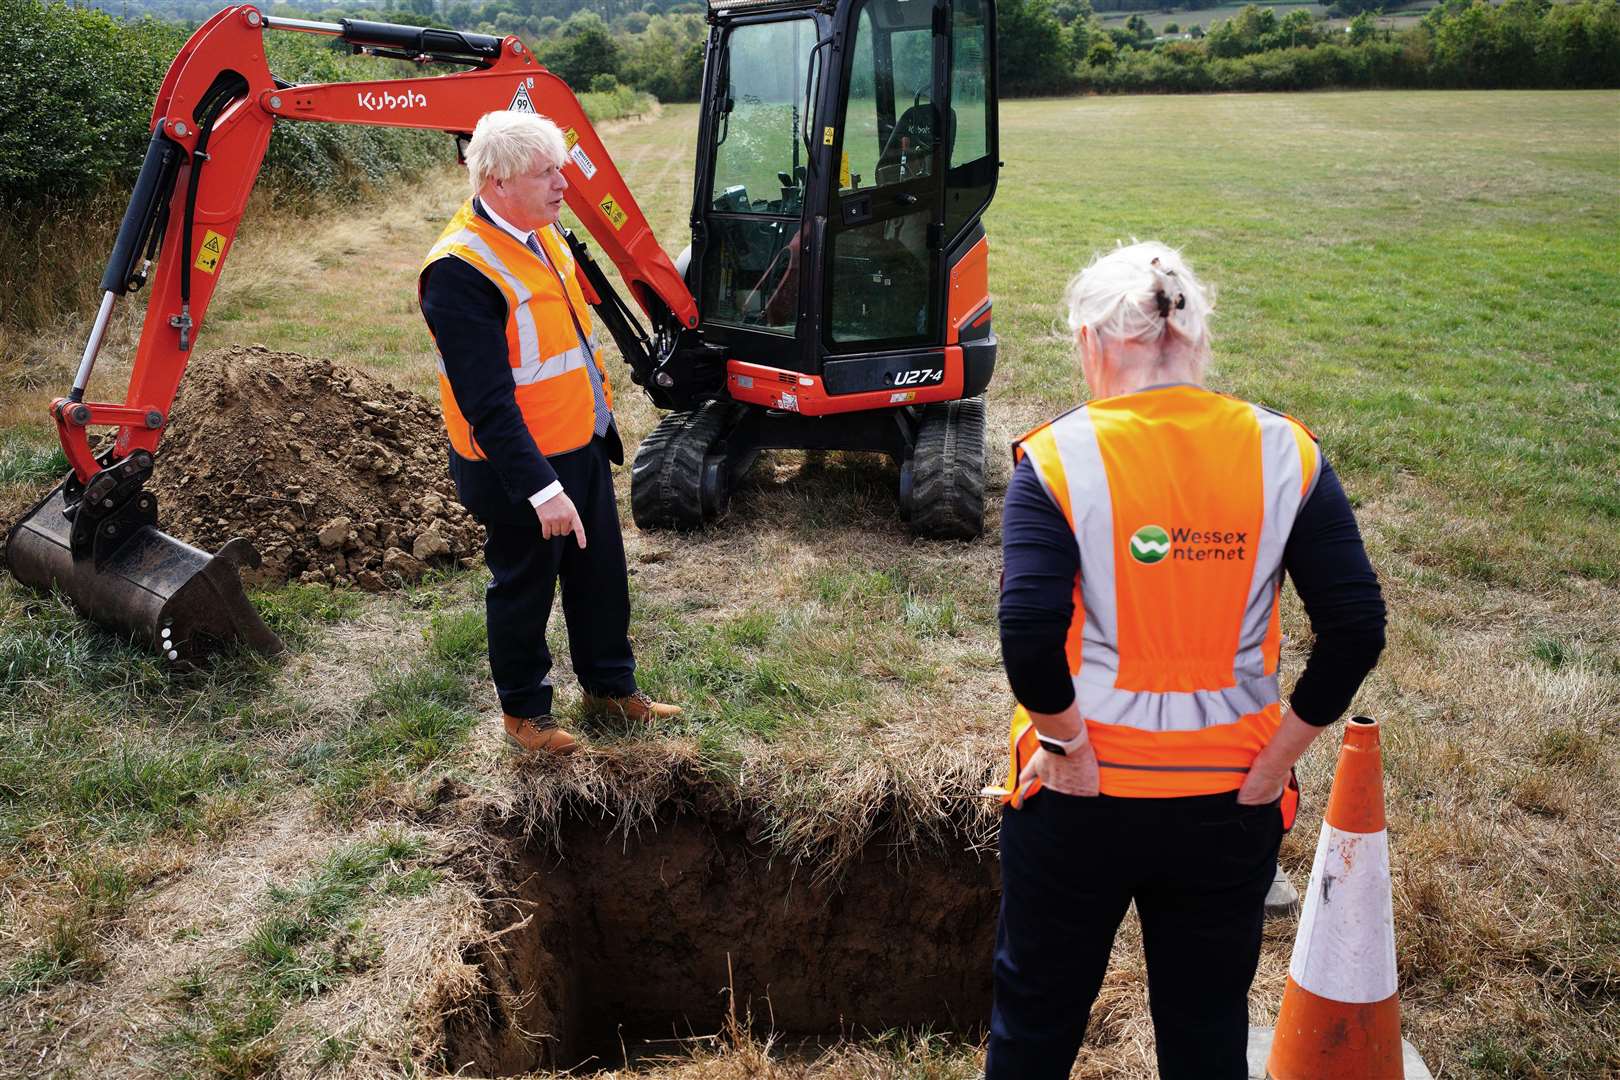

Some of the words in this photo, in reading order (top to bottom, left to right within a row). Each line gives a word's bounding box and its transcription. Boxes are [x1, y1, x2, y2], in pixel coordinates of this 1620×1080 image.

[357, 89, 427, 111] Kubota
[517, 99, 528, 110] 99
[894, 368, 943, 386] U27-4
[1171, 527, 1247, 544] Wessex
